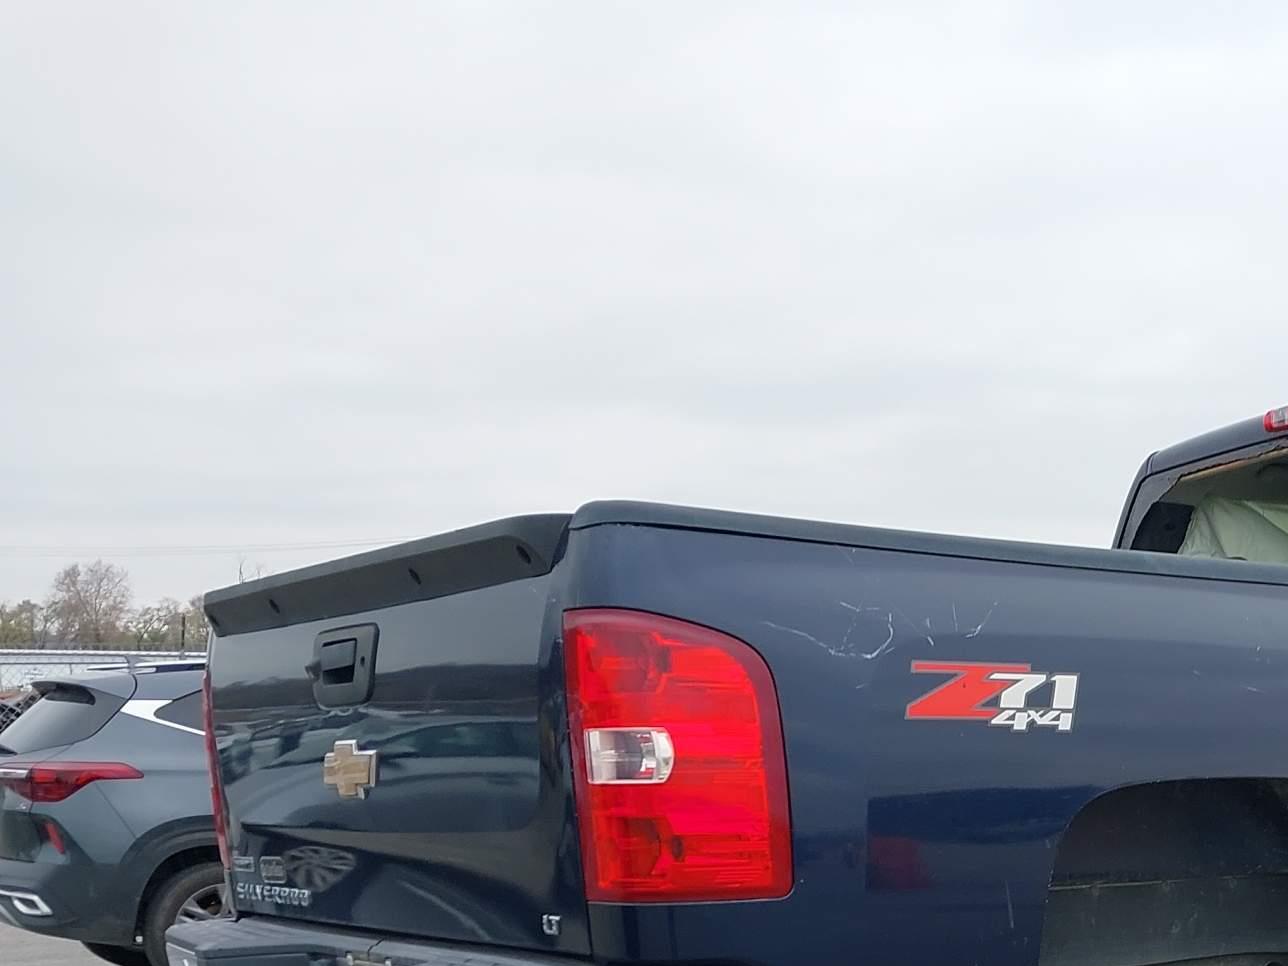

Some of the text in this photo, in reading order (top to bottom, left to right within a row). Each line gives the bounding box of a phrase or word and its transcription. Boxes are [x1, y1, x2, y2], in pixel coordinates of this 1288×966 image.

[905, 660, 1080, 720] Z71
[236, 882, 311, 907] SILVERADO
[542, 914, 561, 936] LT
